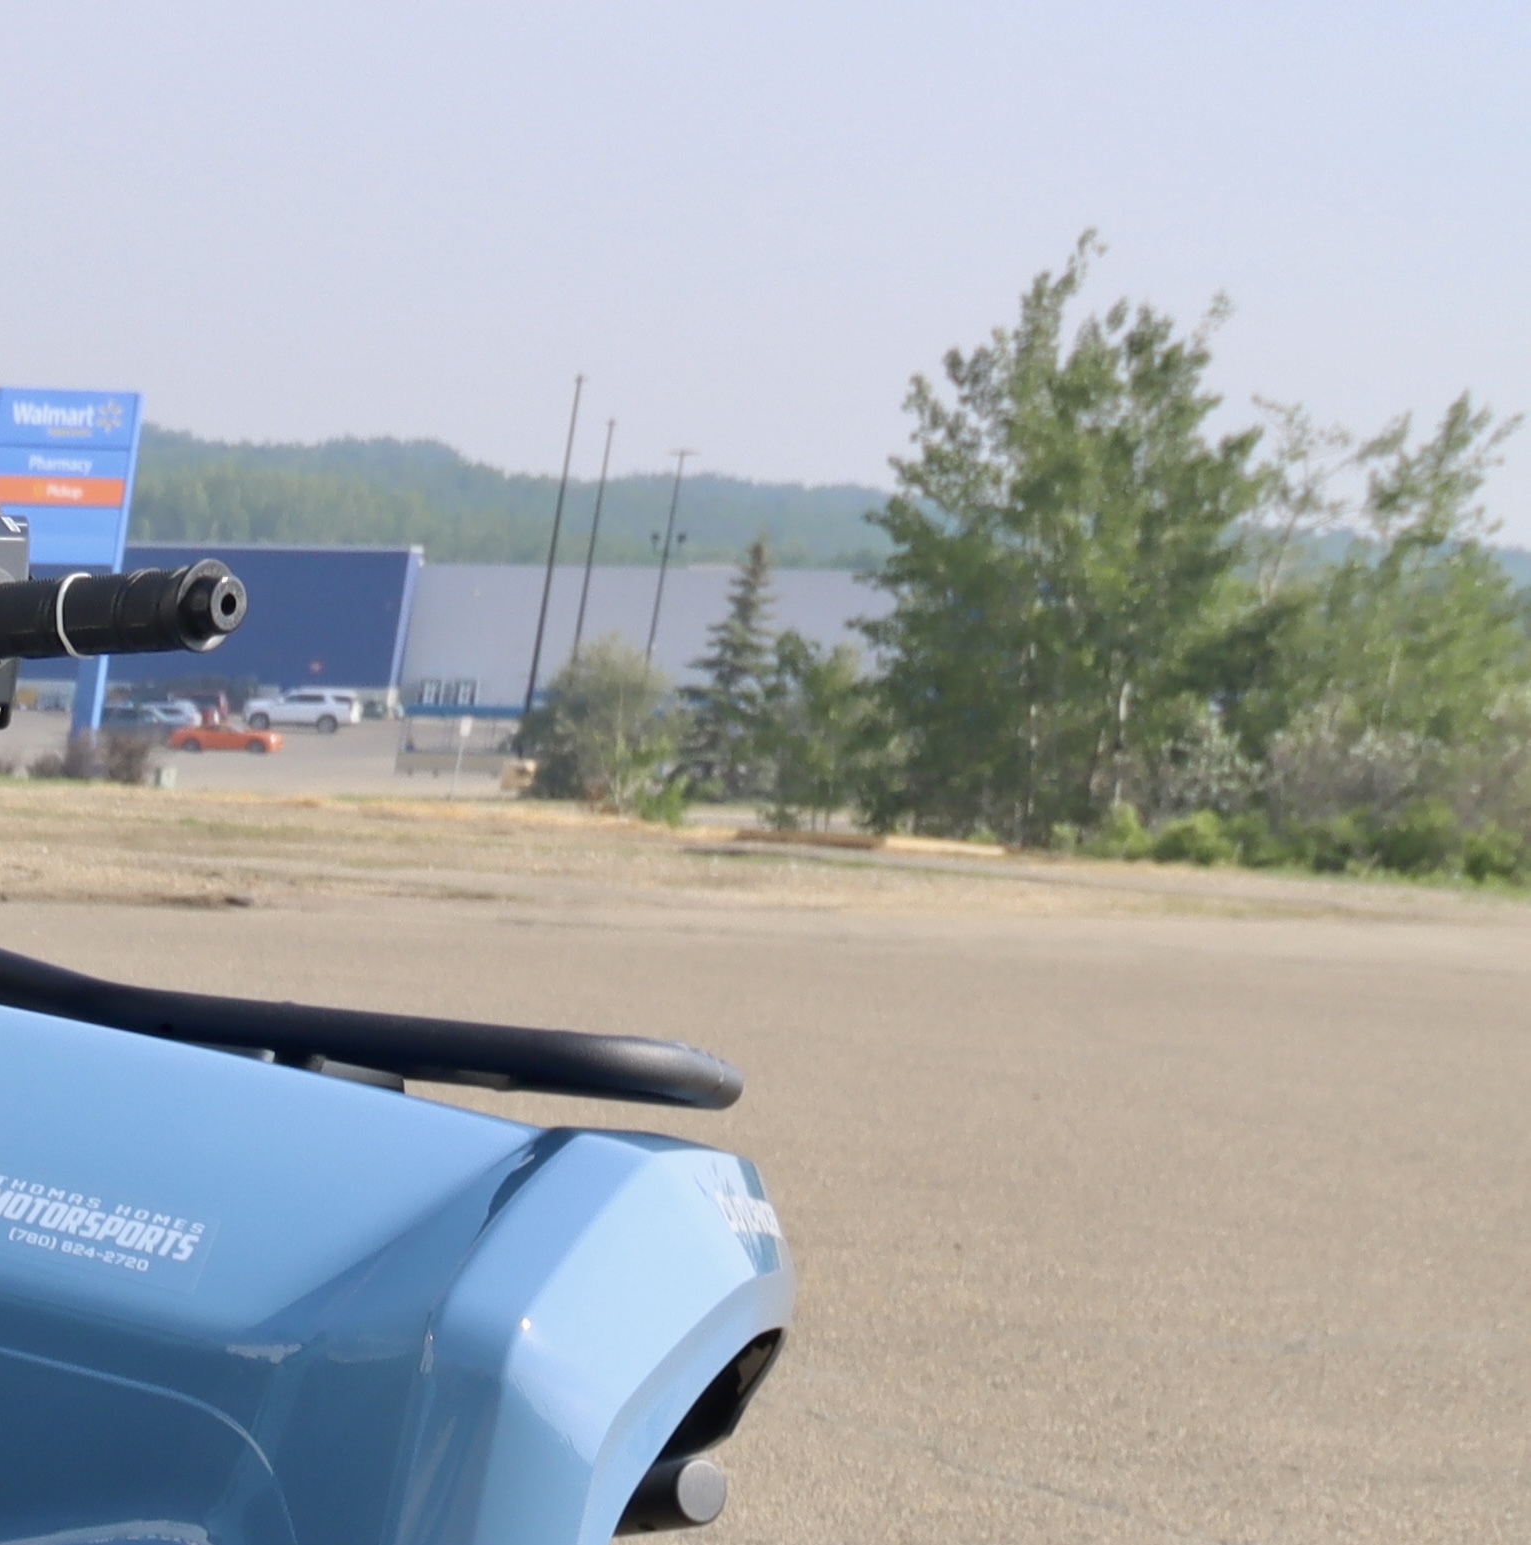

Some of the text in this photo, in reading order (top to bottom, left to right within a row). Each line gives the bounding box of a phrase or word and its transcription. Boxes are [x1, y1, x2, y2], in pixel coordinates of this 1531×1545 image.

[13, 401, 94, 427] Walmart
[28, 454, 93, 475] Pharmacy
[46, 483, 83, 499] Pickup
[115, 1203, 206, 1235] HOMES
[8, 1227, 57, 1250] (780)
